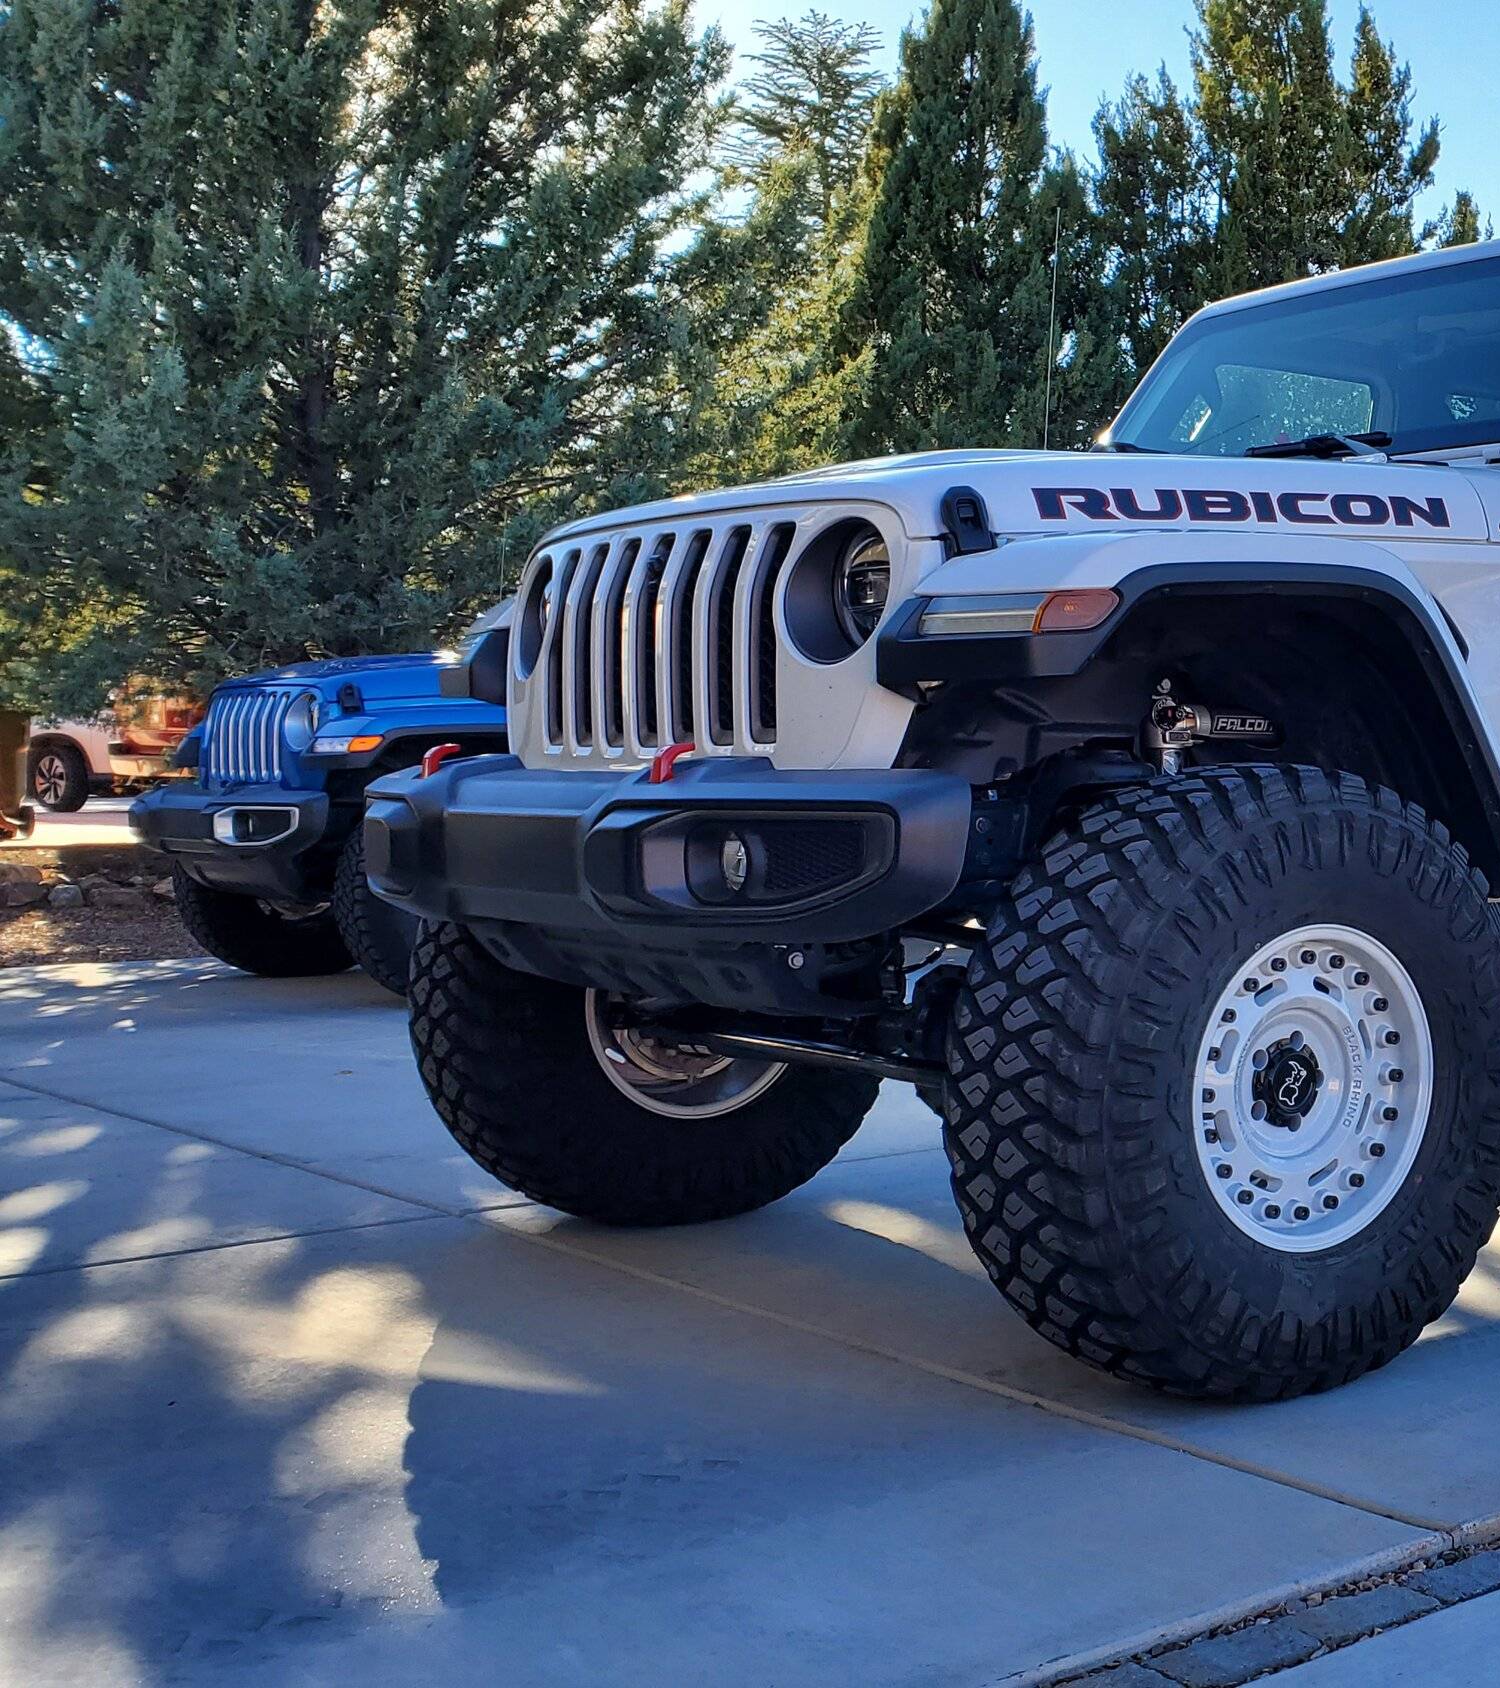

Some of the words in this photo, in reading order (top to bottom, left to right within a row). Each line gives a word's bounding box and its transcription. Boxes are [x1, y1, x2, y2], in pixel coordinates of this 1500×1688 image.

[1030, 487, 1451, 528] RUBICON
[1342, 1025, 1362, 1074] BLACK
[1342, 1079, 1362, 1128] RHINO
